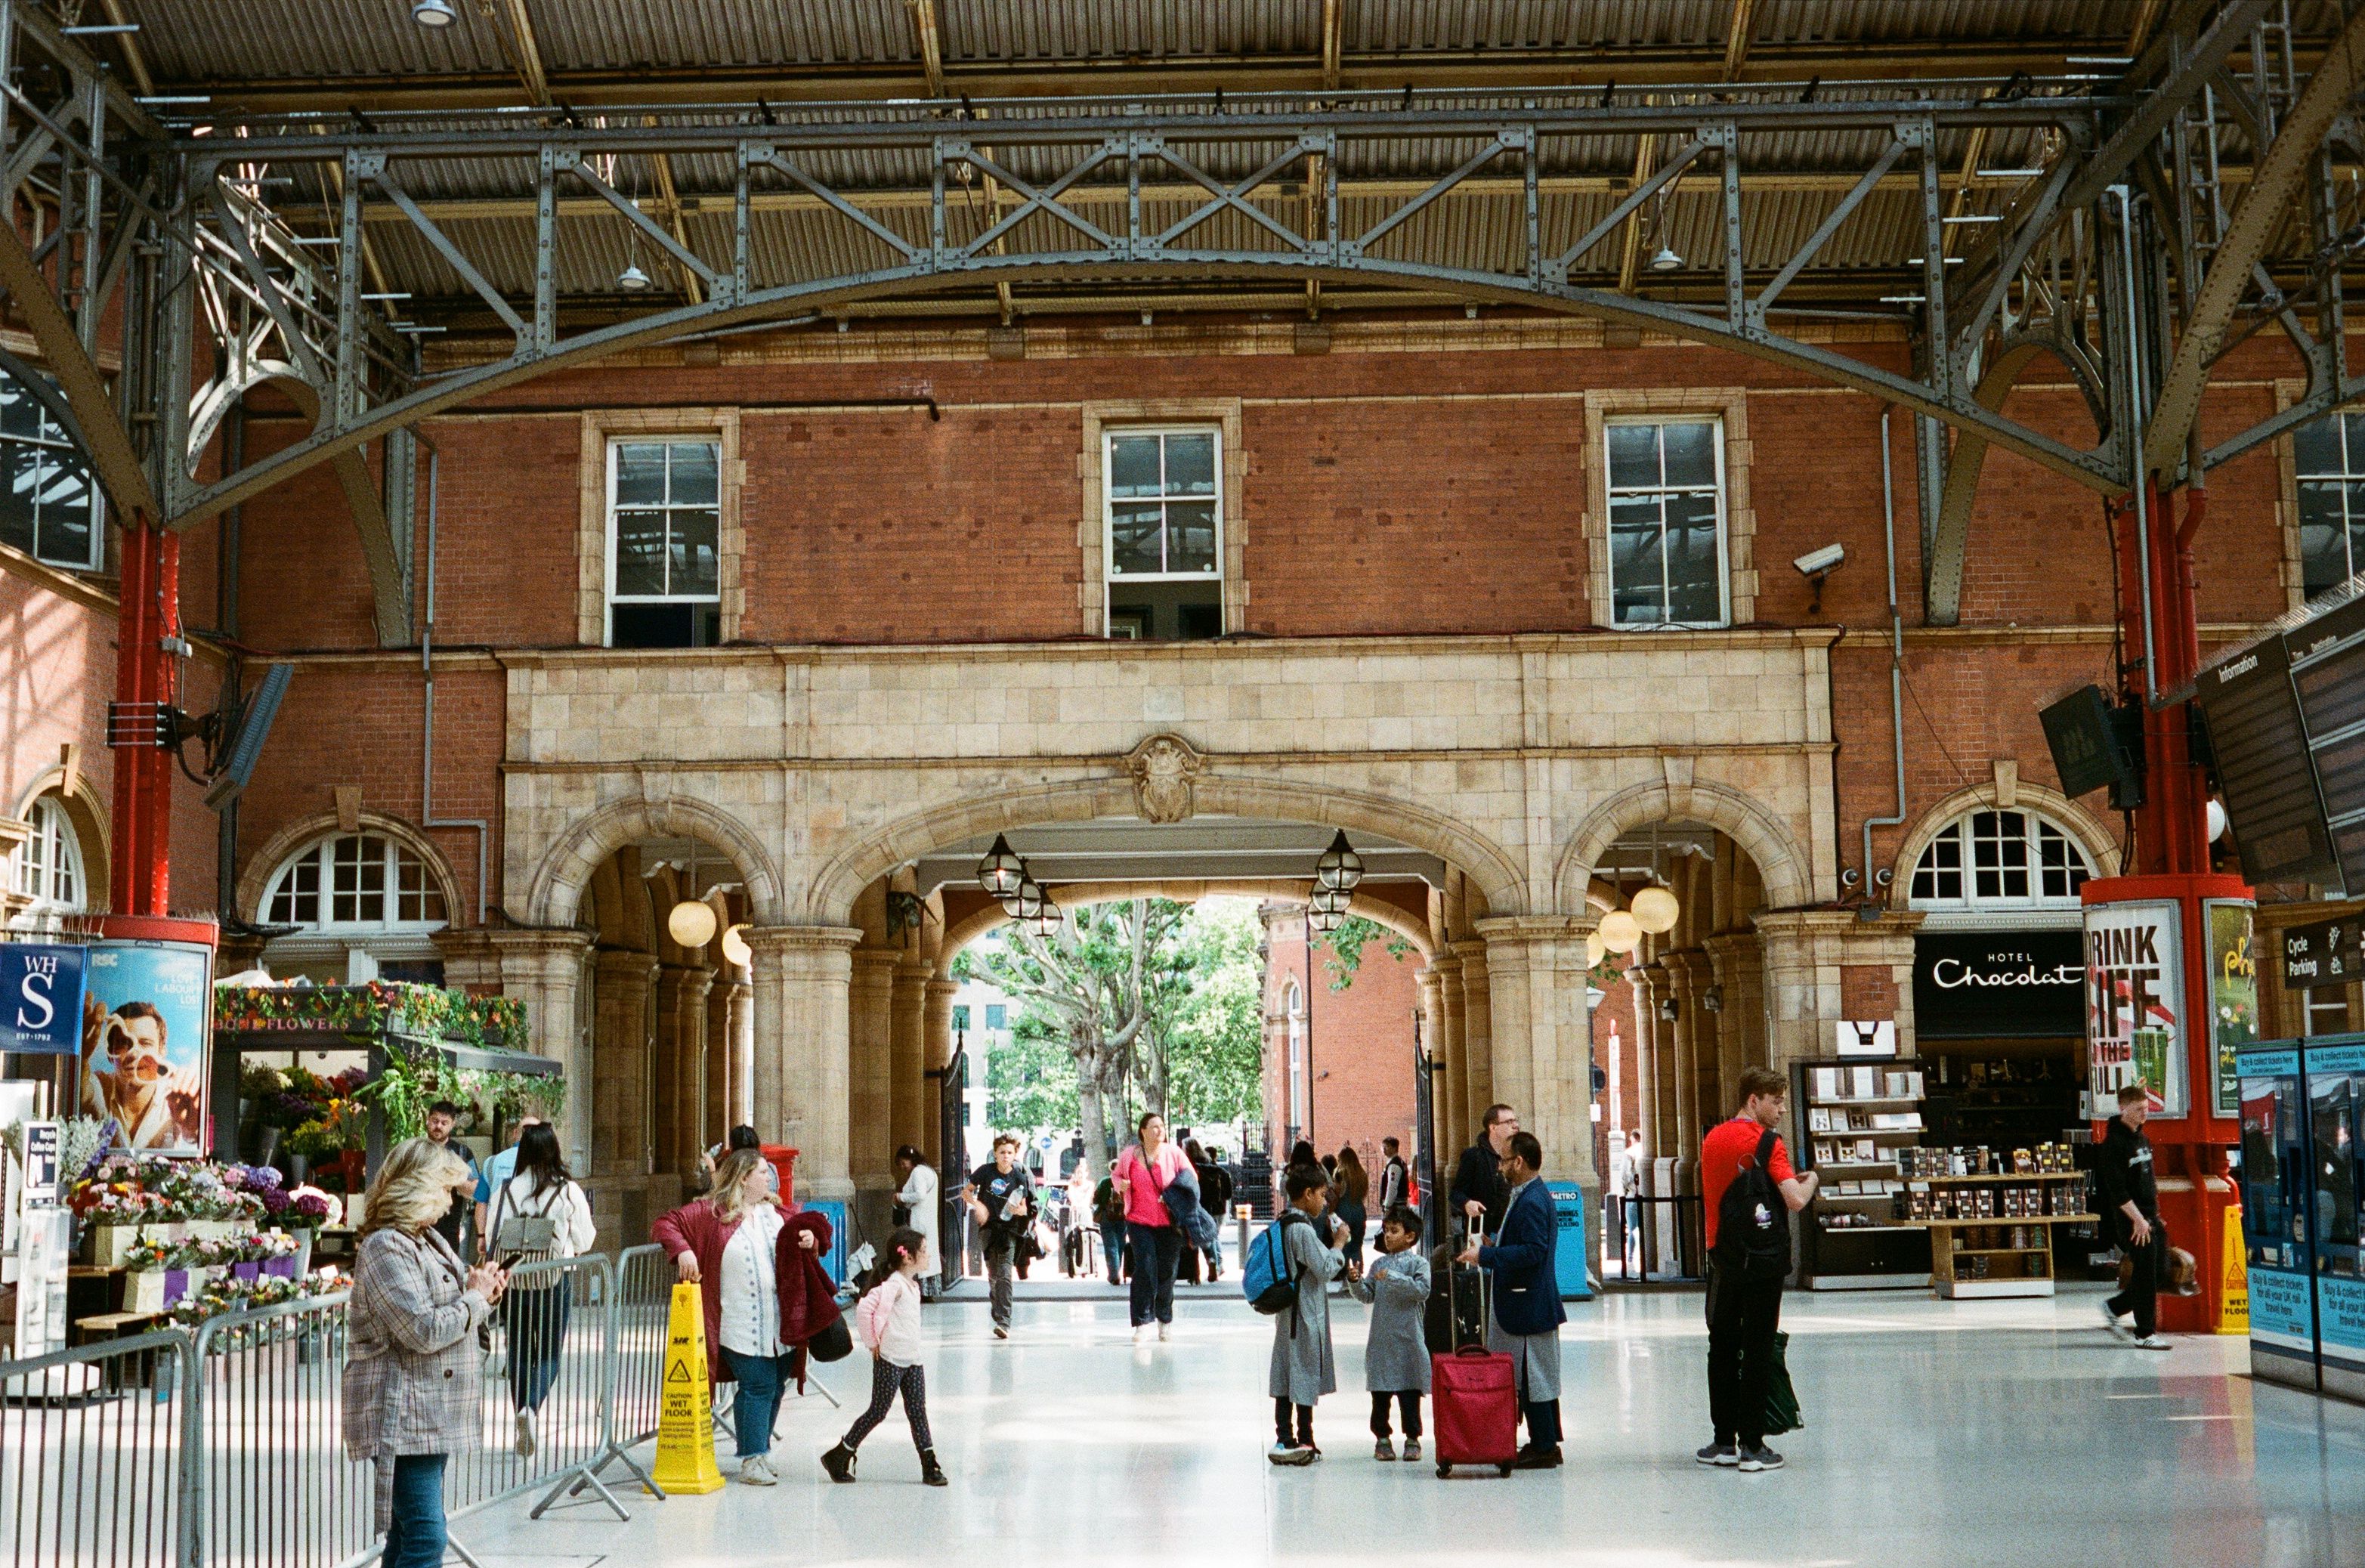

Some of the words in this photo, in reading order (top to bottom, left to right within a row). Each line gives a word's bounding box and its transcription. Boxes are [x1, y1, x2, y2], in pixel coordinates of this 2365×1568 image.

[2218, 655, 2258, 683] Information
[2288, 936, 2308, 956] Cycle
[24, 955, 58, 973] WH
[1988, 953, 2033, 962] HOTEL
[1934, 957, 2085, 988] Chocolat
[2289, 958, 2317, 976] Parking
[17, 972, 54, 1029] S
[2101, 1041, 2129, 1062] THE
[2253, 1273, 2263, 1286] Buy
[2268, 1276, 2285, 1288] collect
[2286, 1279, 2303, 1291] tickets
[2271, 1291, 2282, 1301] your
[2324, 1284, 2336, 1297] Buy
[2342, 1288, 2361, 1299] collect
[2266, 1303, 2280, 1314] travel
[2281, 1305, 2292, 1316] here
[2346, 1304, 2358, 1313] your
[2340, 1315, 2356, 1327] travel
[665, 1409, 693, 1417] FLOOR
